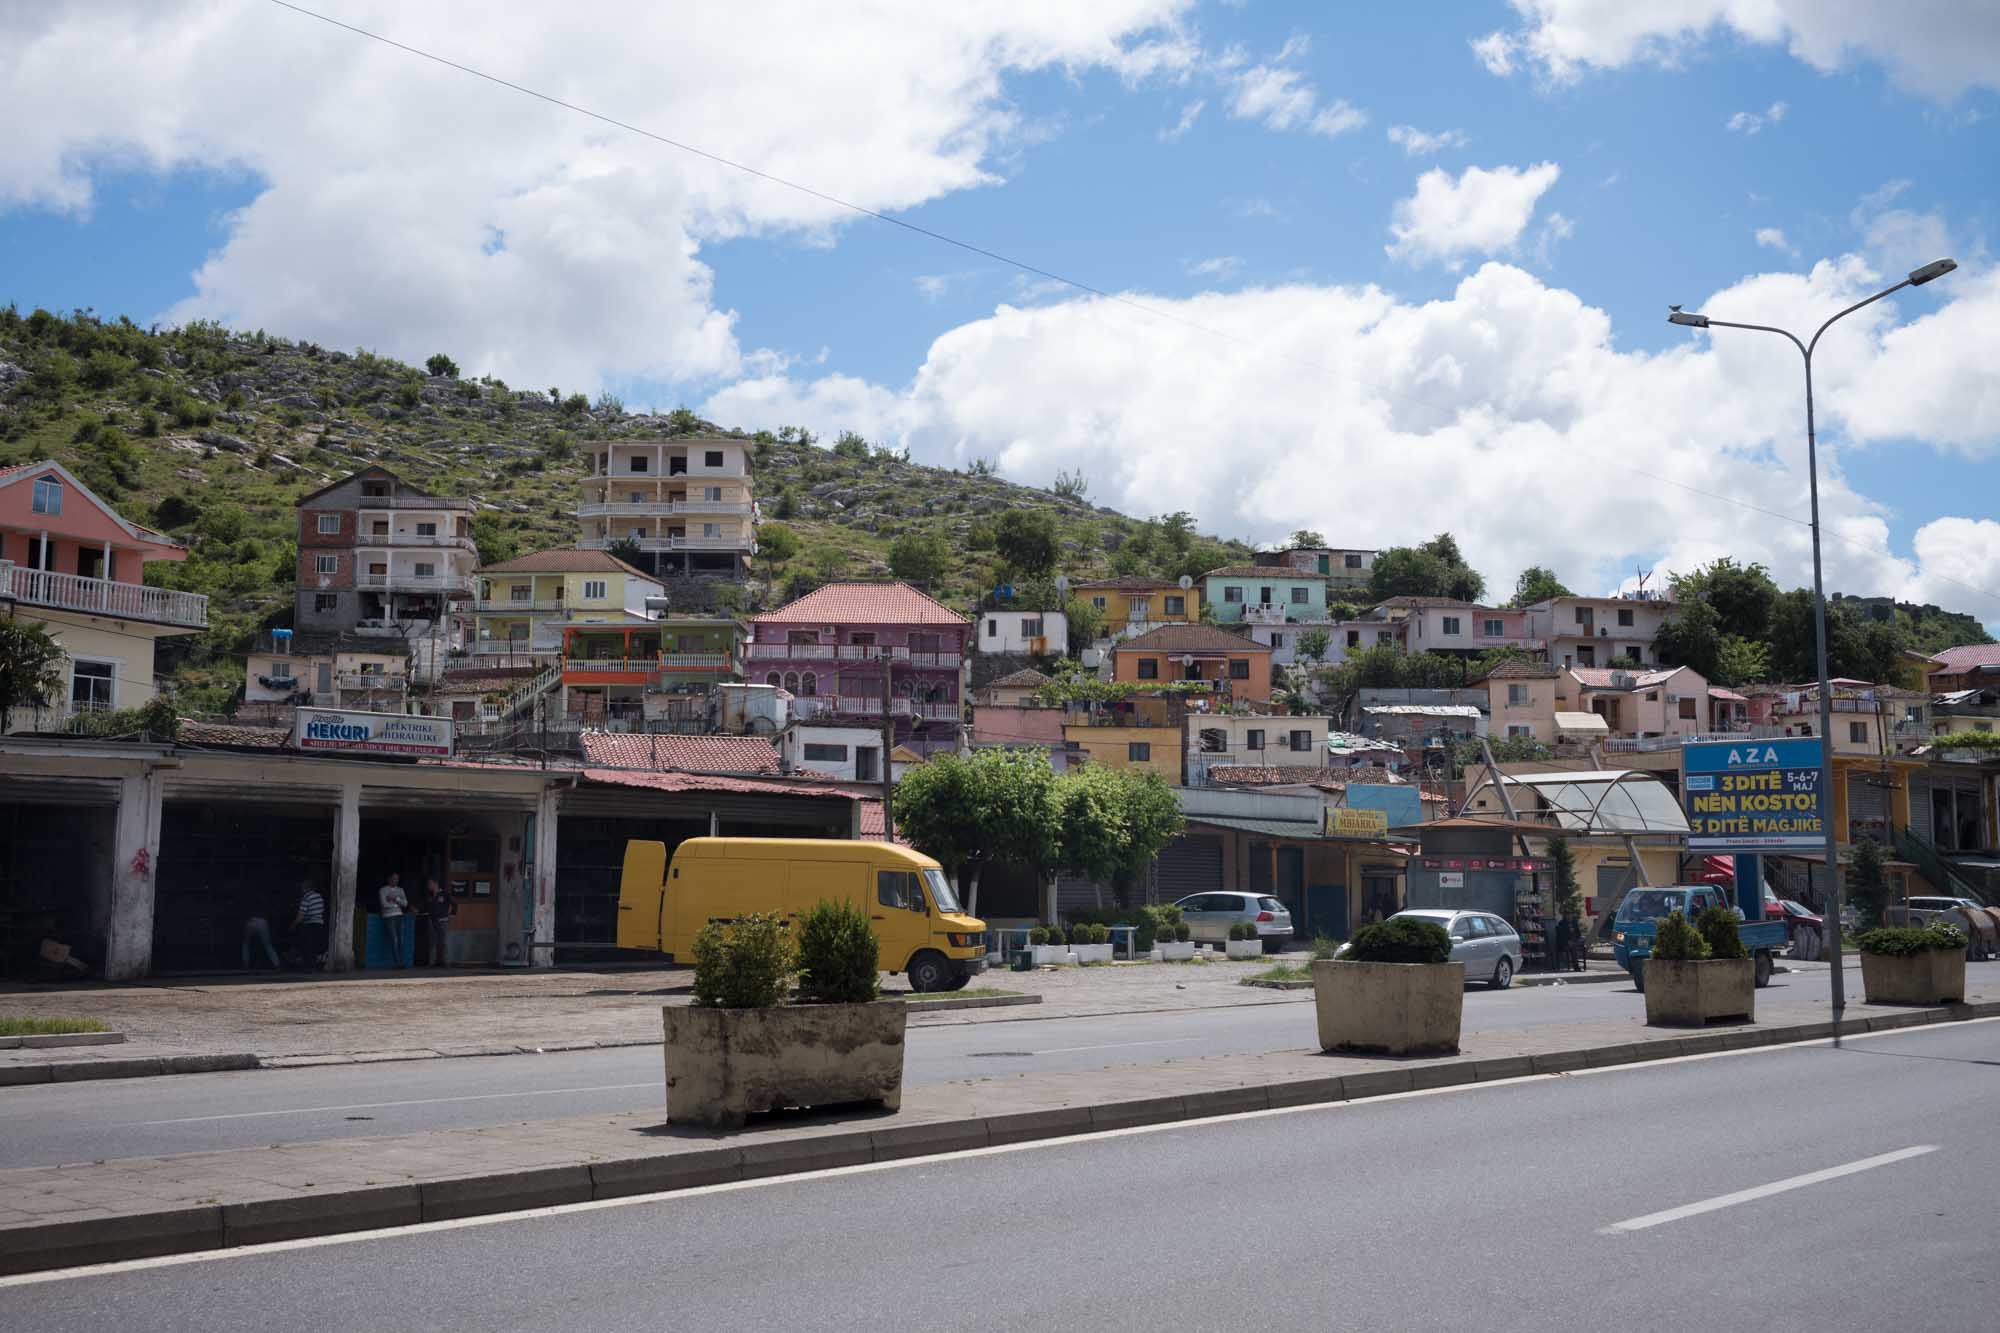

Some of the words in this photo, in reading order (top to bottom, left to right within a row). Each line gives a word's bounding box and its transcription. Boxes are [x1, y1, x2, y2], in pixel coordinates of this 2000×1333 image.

[307, 722, 370, 741] HEKURI
[1728, 747, 1779, 764] AZA
[1722, 775, 1734, 791] 3
[1736, 771, 1782, 791] DITË
[1787, 771, 1818, 782] 5-6-7
[1793, 782, 1813, 791] MAJ
[1694, 792, 1736, 812] NËN
[1741, 793, 1817, 811] KOSTO!
[1708, 816, 1750, 833] DITË
[1753, 818, 1823, 832] MAGJIKE
